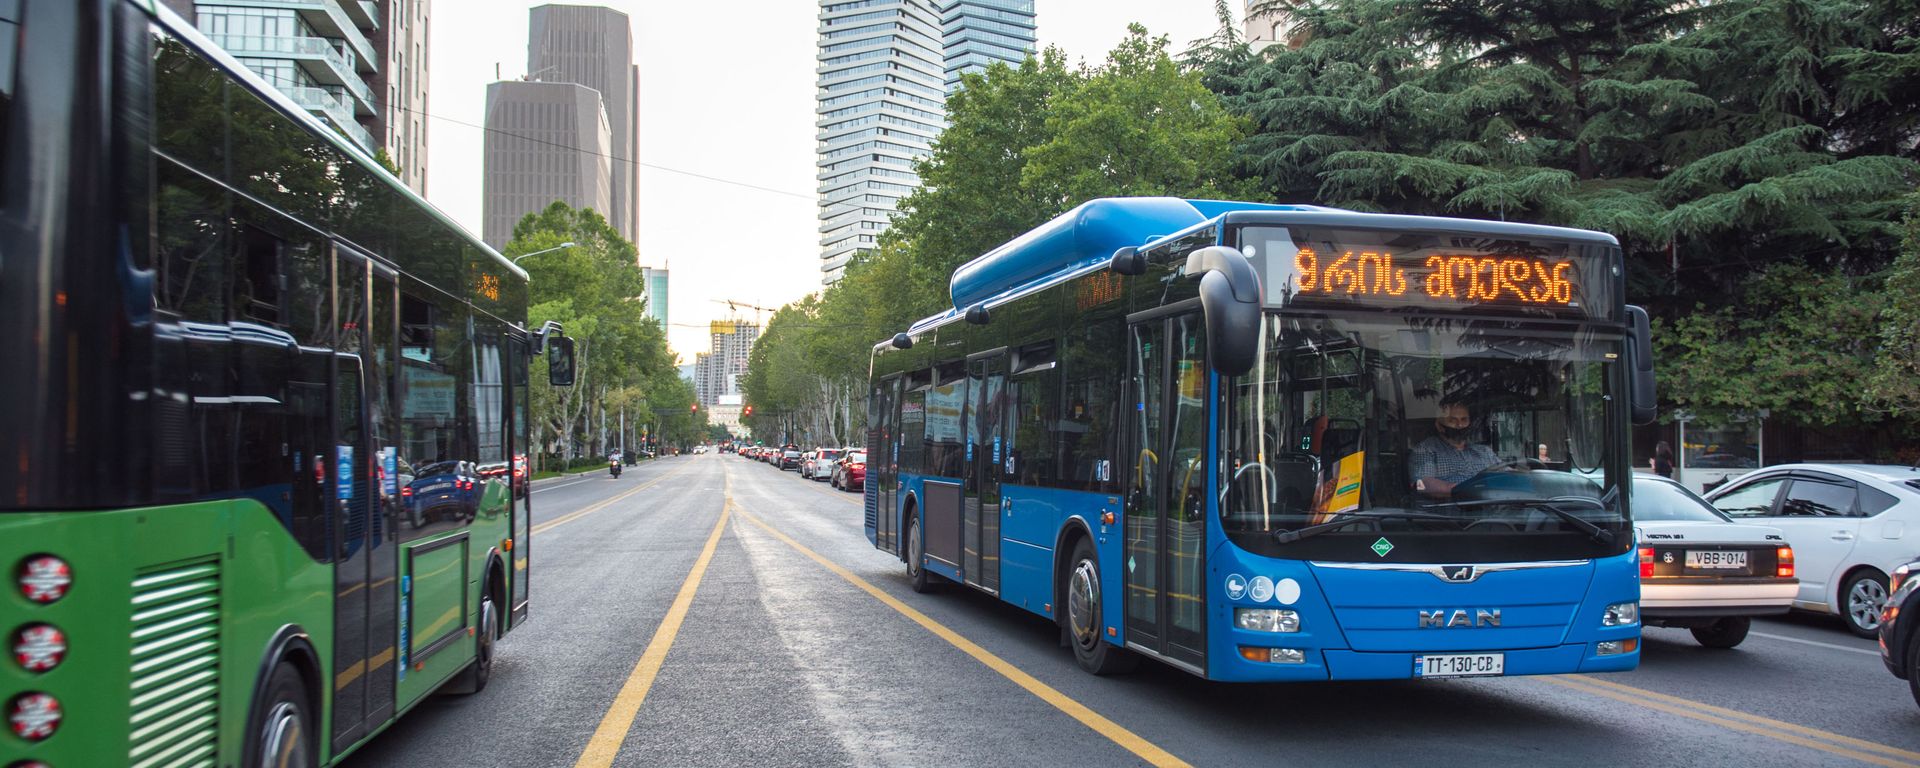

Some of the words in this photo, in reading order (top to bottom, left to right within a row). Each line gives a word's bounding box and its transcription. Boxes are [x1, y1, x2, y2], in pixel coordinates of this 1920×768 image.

[1426, 256, 1571, 303] მოედან
[1419, 608, 1501, 628] MAN
[1427, 656, 1493, 673] TT-130-CB
